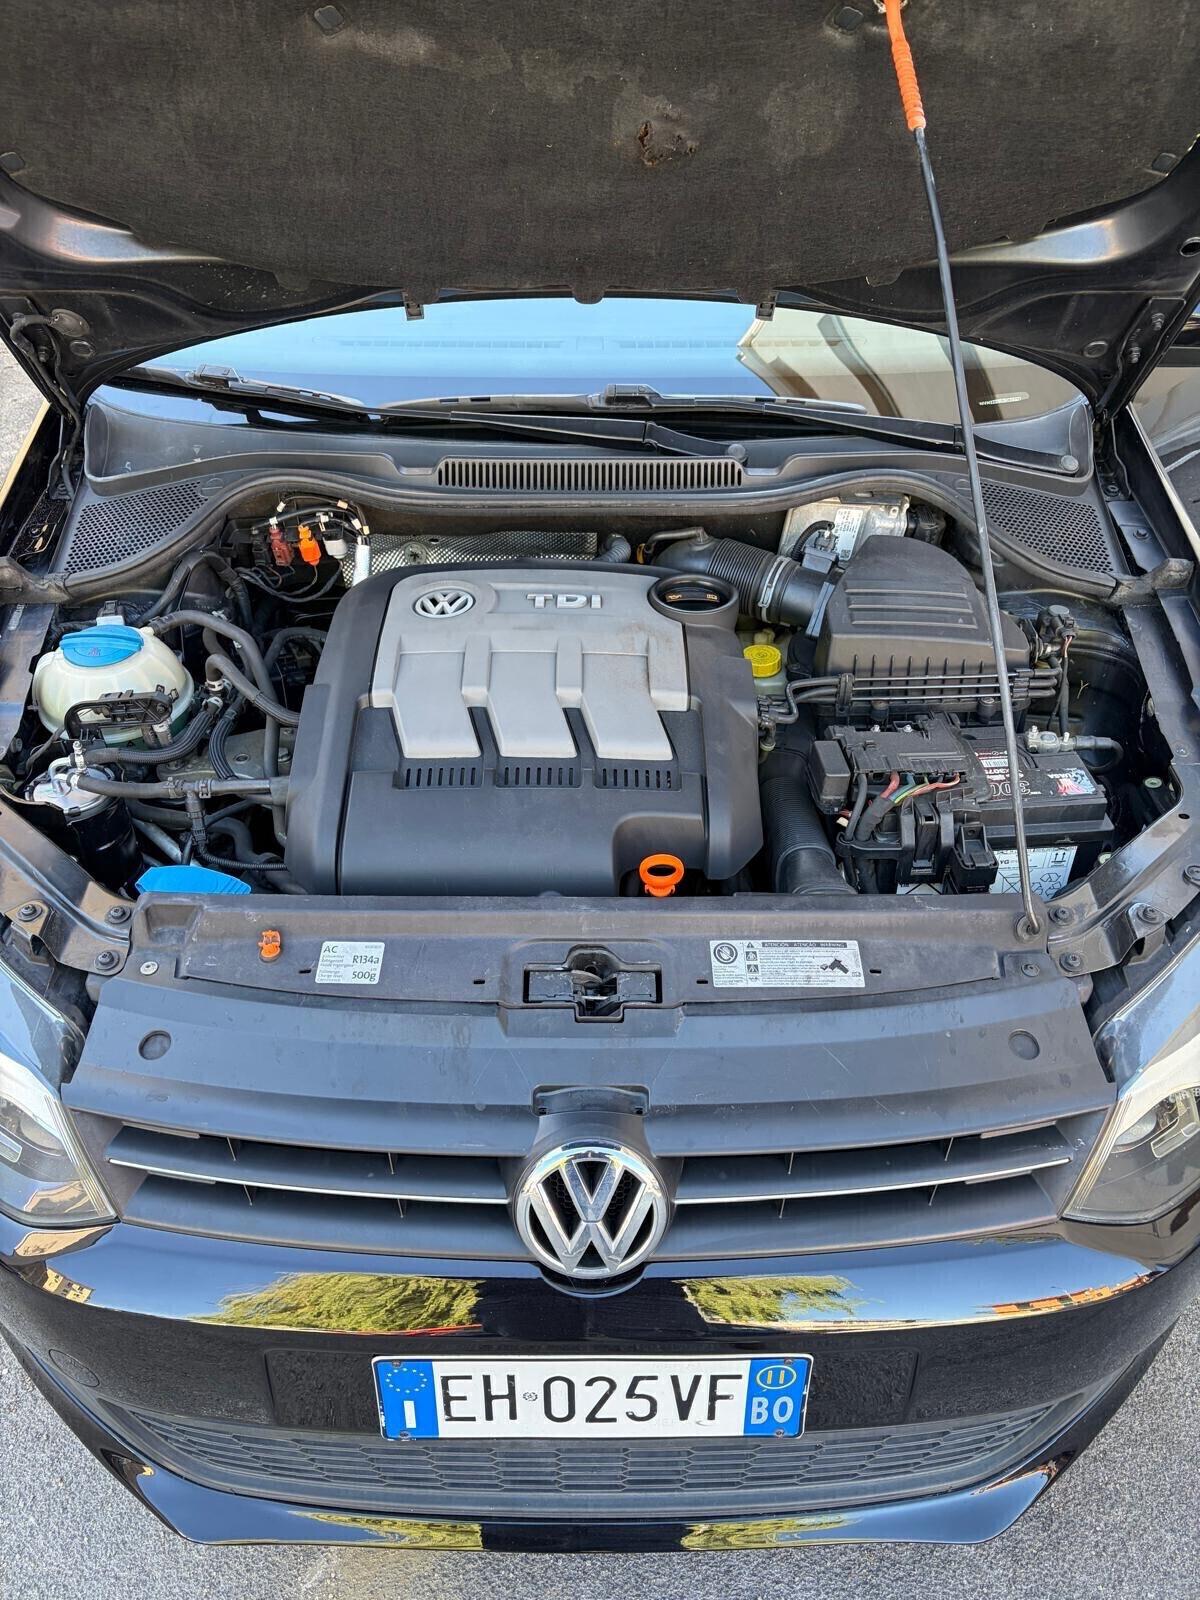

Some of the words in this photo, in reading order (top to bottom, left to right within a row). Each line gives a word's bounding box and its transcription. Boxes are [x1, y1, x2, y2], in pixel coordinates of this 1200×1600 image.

[414, 589, 475, 618] VW
[526, 593, 602, 609] TDI
[323, 945, 338, 953] AC
[352, 954, 380, 964] R134a
[352, 971, 376, 982] 500g
[516, 1147, 667, 1280] VW
[440, 1374, 518, 1422] EH
[542, 1374, 743, 1423] 025VF
[750, 1396, 794, 1425] BO
